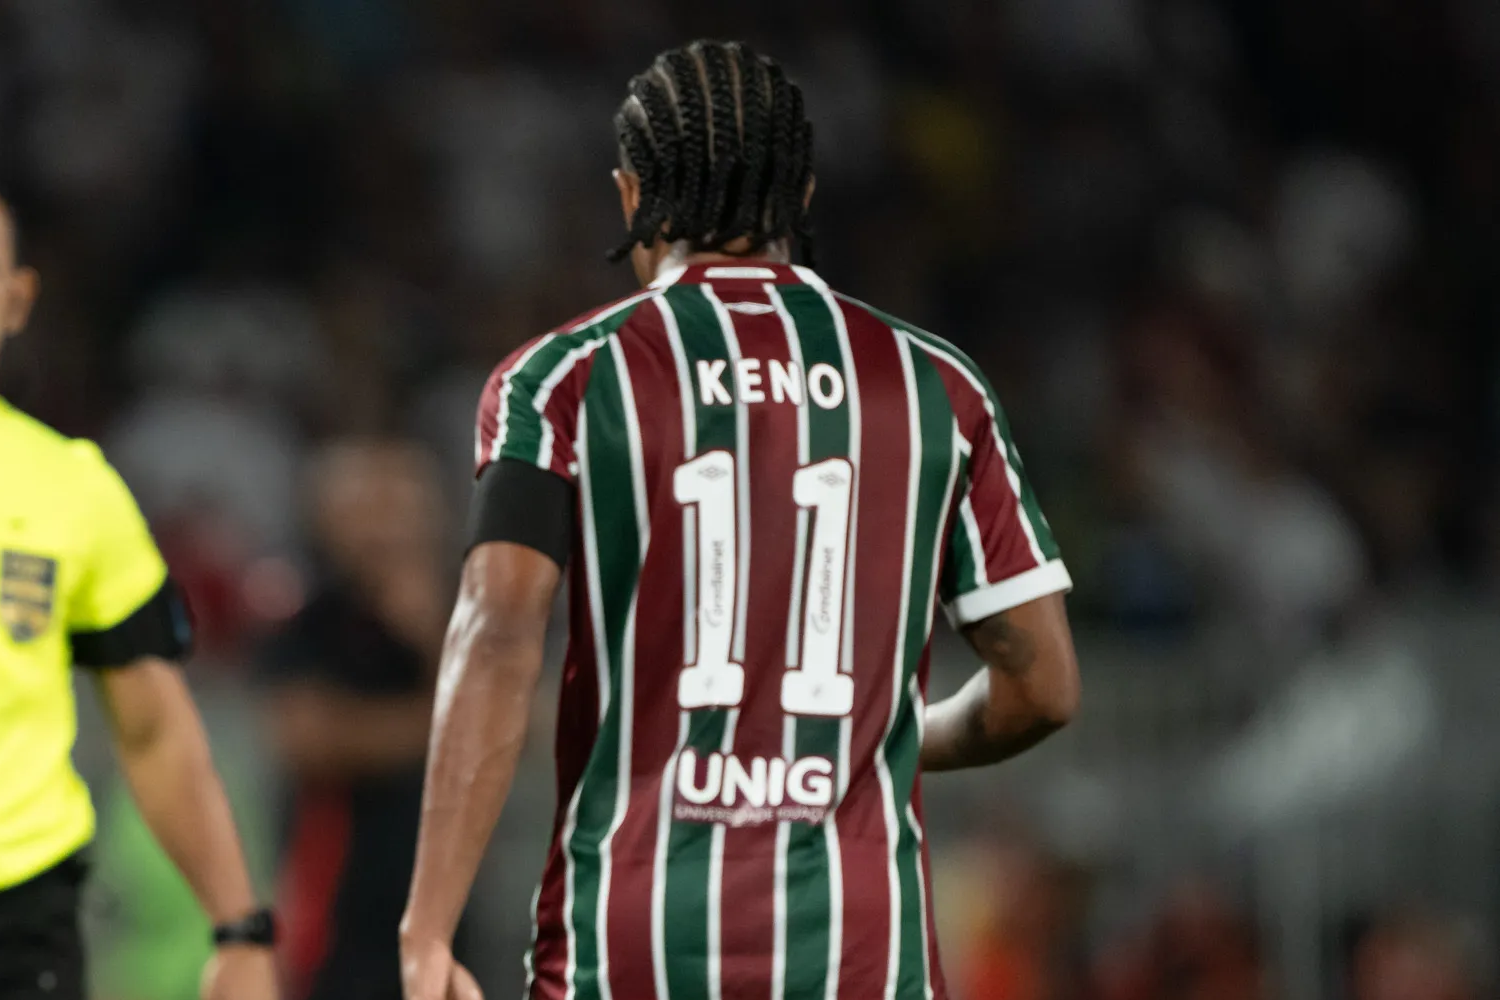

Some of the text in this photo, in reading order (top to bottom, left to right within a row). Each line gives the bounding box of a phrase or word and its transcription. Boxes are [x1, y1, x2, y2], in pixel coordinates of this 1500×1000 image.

[696, 358, 845, 410] KENO
[673, 449, 855, 716] 11
[677, 749, 833, 807] UNIG
